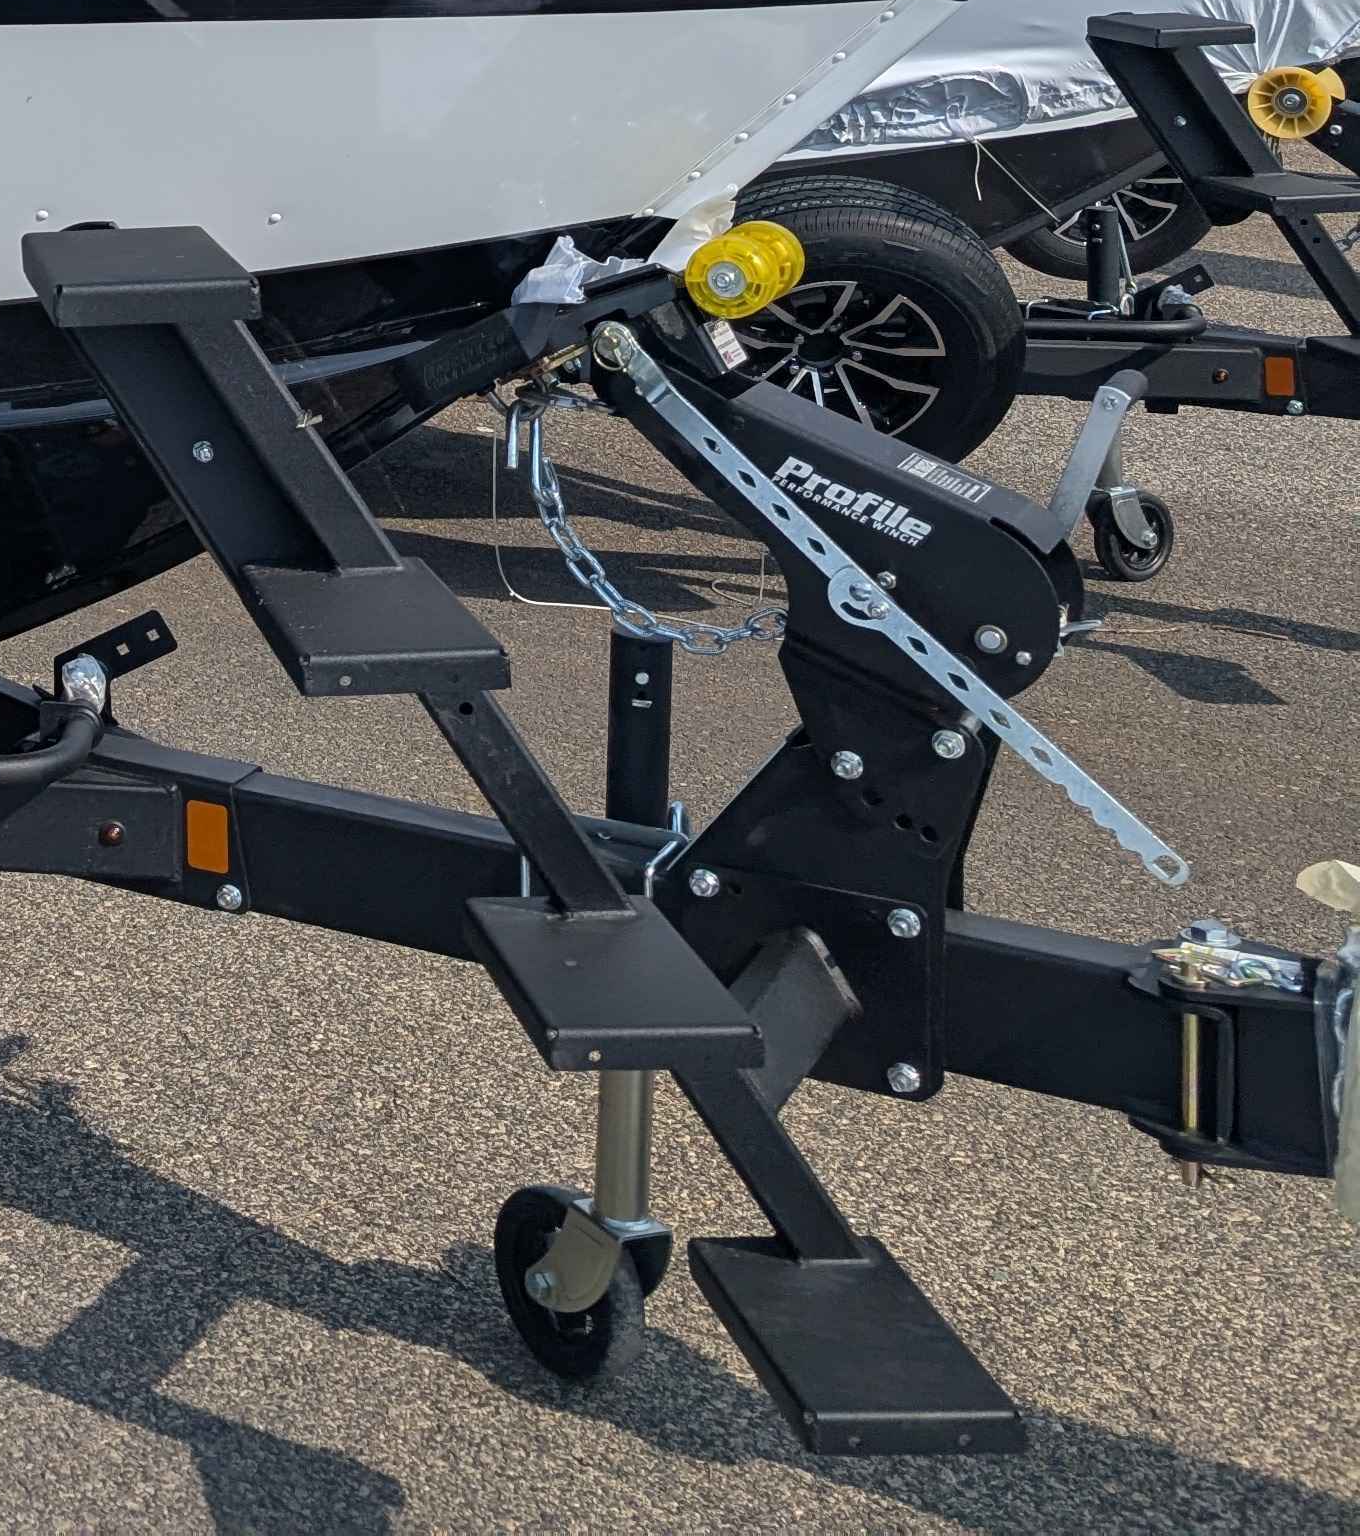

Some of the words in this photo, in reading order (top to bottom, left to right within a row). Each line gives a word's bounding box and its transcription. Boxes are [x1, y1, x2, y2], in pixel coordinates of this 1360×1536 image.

[770, 475, 868, 525] PERFORMANCE
[872, 519, 921, 547] WINCH
[775, 455, 932, 541] Profile
